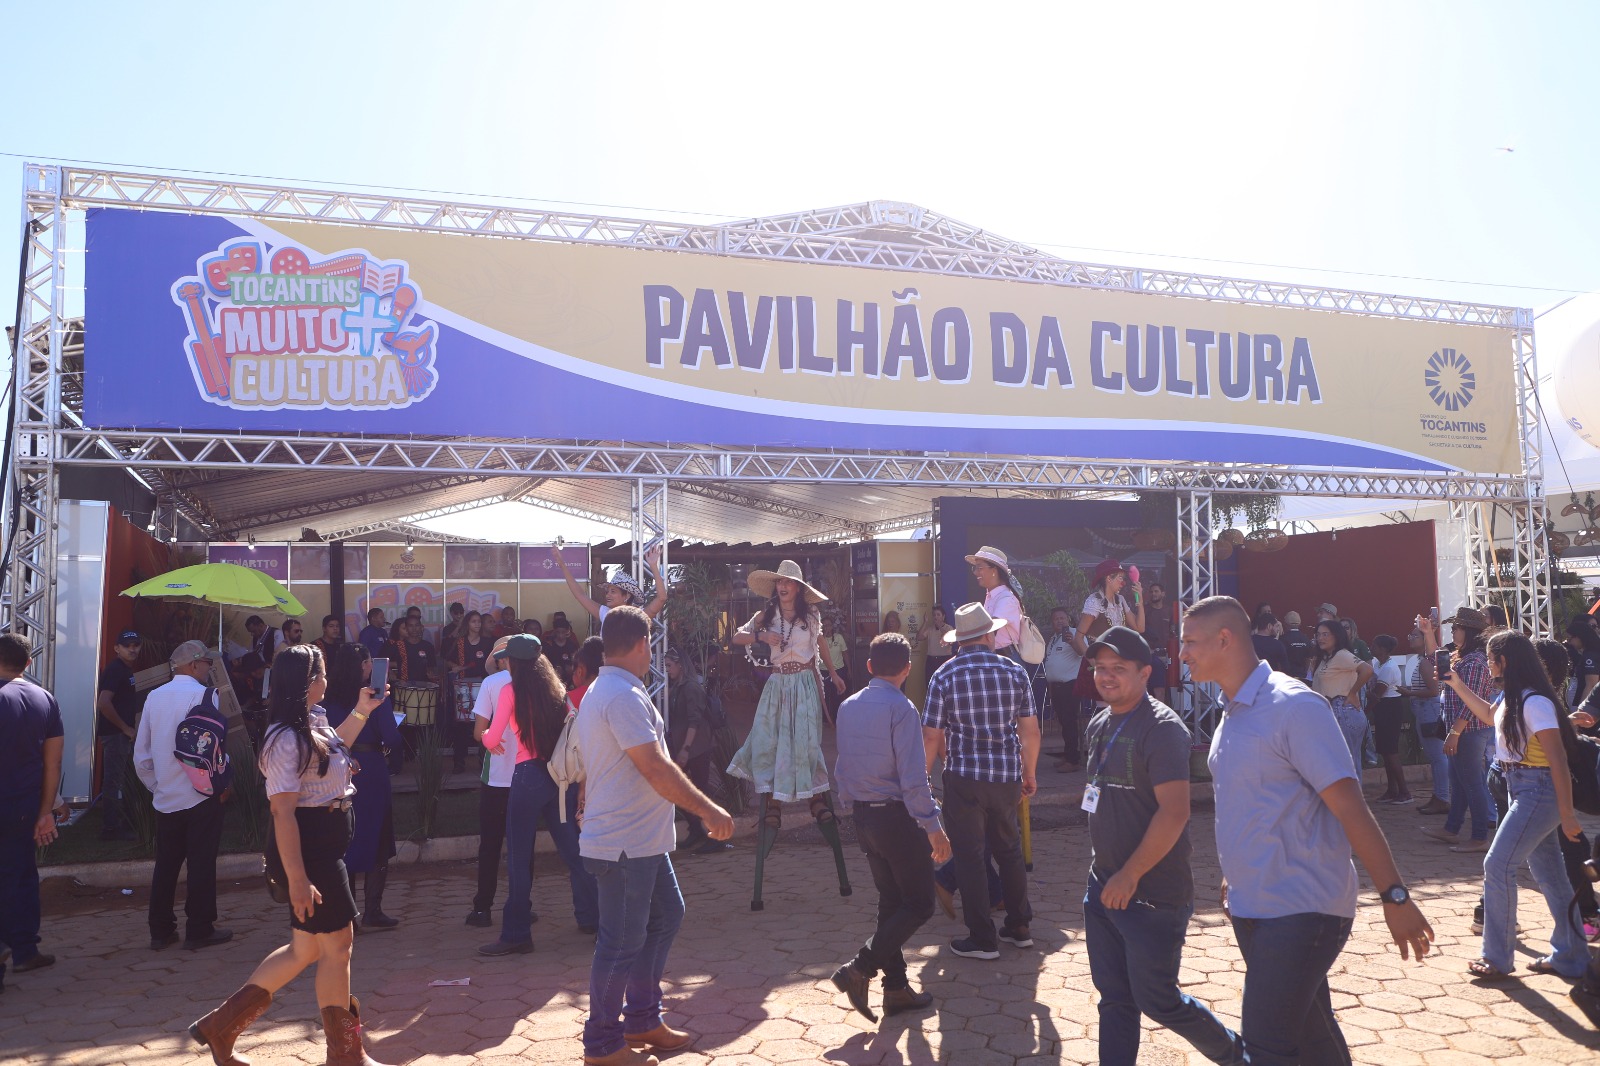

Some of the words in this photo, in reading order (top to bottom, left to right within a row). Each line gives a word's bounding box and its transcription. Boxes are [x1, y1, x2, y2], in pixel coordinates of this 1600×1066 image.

[223, 307, 346, 354] MUITO
[642, 284, 973, 385] PAVILHÃO
[989, 311, 1075, 390] DA
[1089, 320, 1324, 406] CULTURA
[232, 358, 407, 402] CULTURA
[1420, 419, 1487, 433] TOCANTINS
